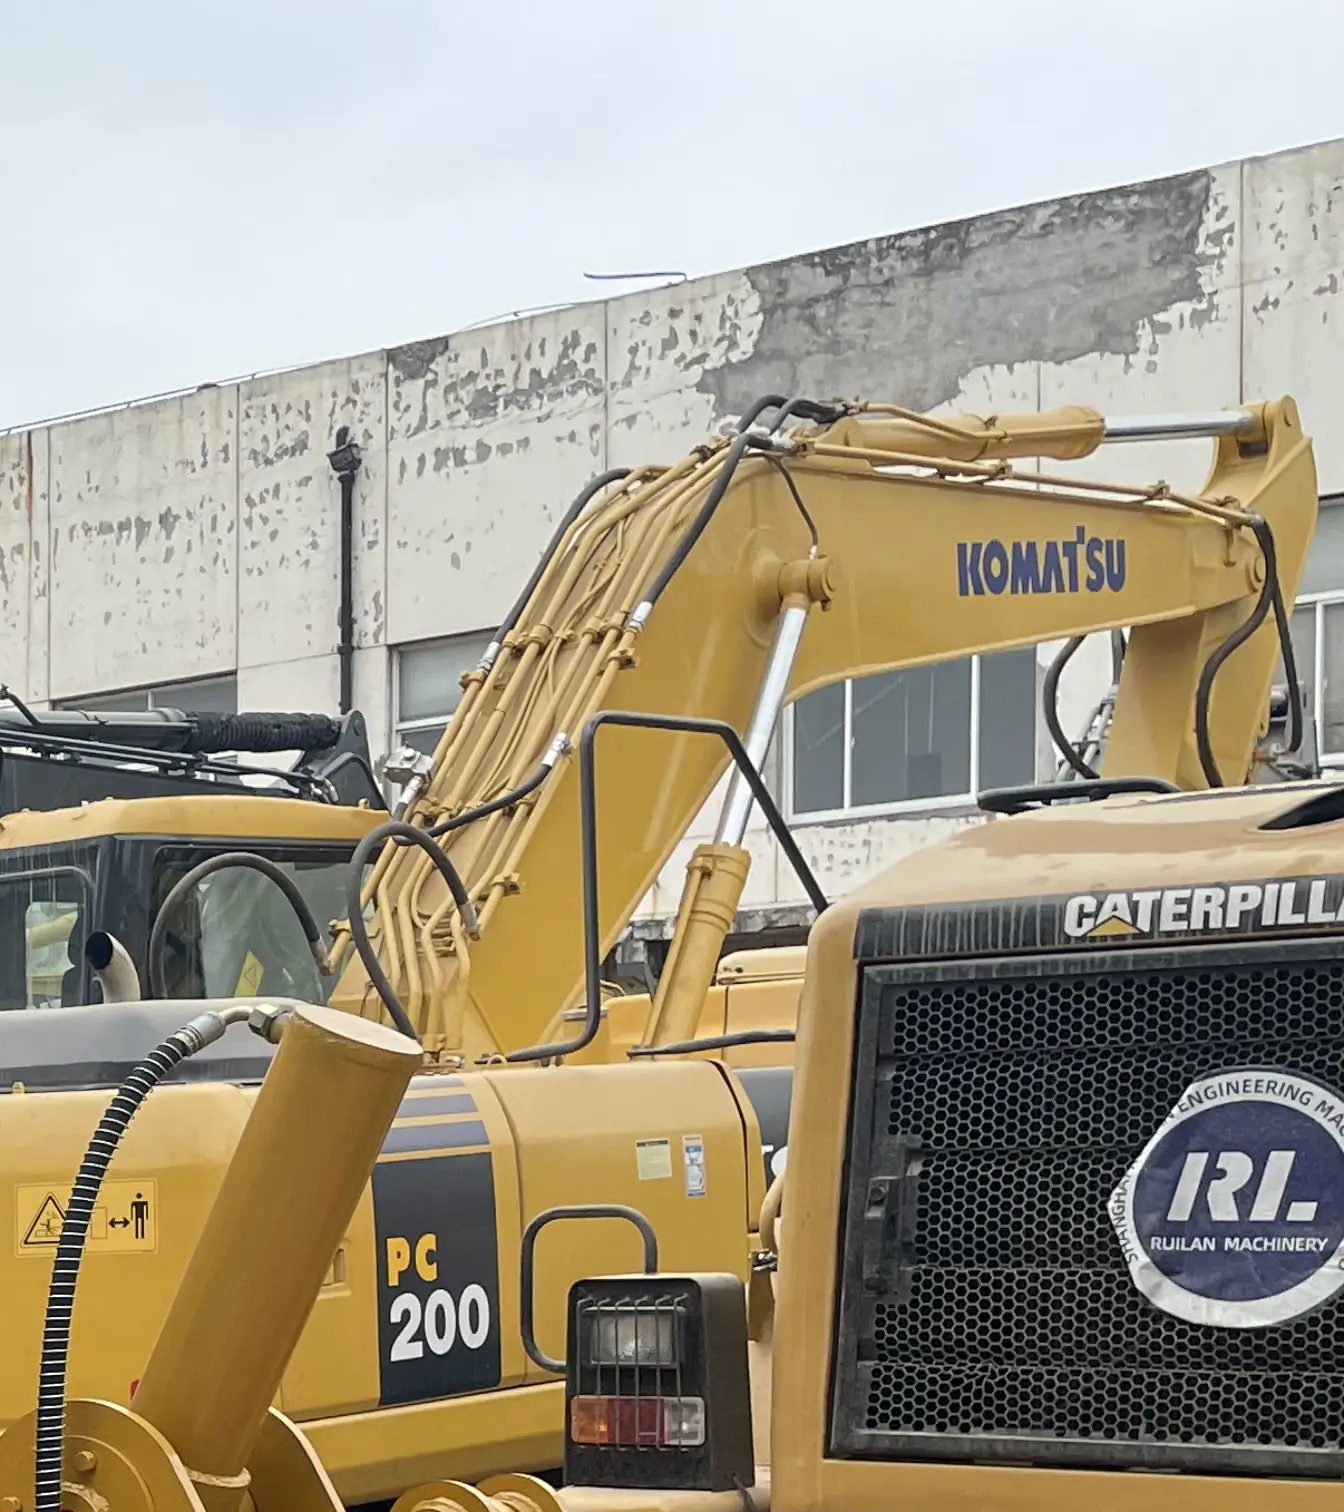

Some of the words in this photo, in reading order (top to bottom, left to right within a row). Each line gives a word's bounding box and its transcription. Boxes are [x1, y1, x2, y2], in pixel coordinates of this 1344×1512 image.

[957, 525, 1126, 596] KOMATSU
[1179, 1079, 1314, 1113] ENGINEERING
[386, 1233, 438, 1286] PC
[1150, 1236, 1216, 1251] RUILAN
[1224, 1237, 1329, 1251] MACHINERY
[389, 1283, 490, 1362] 200
